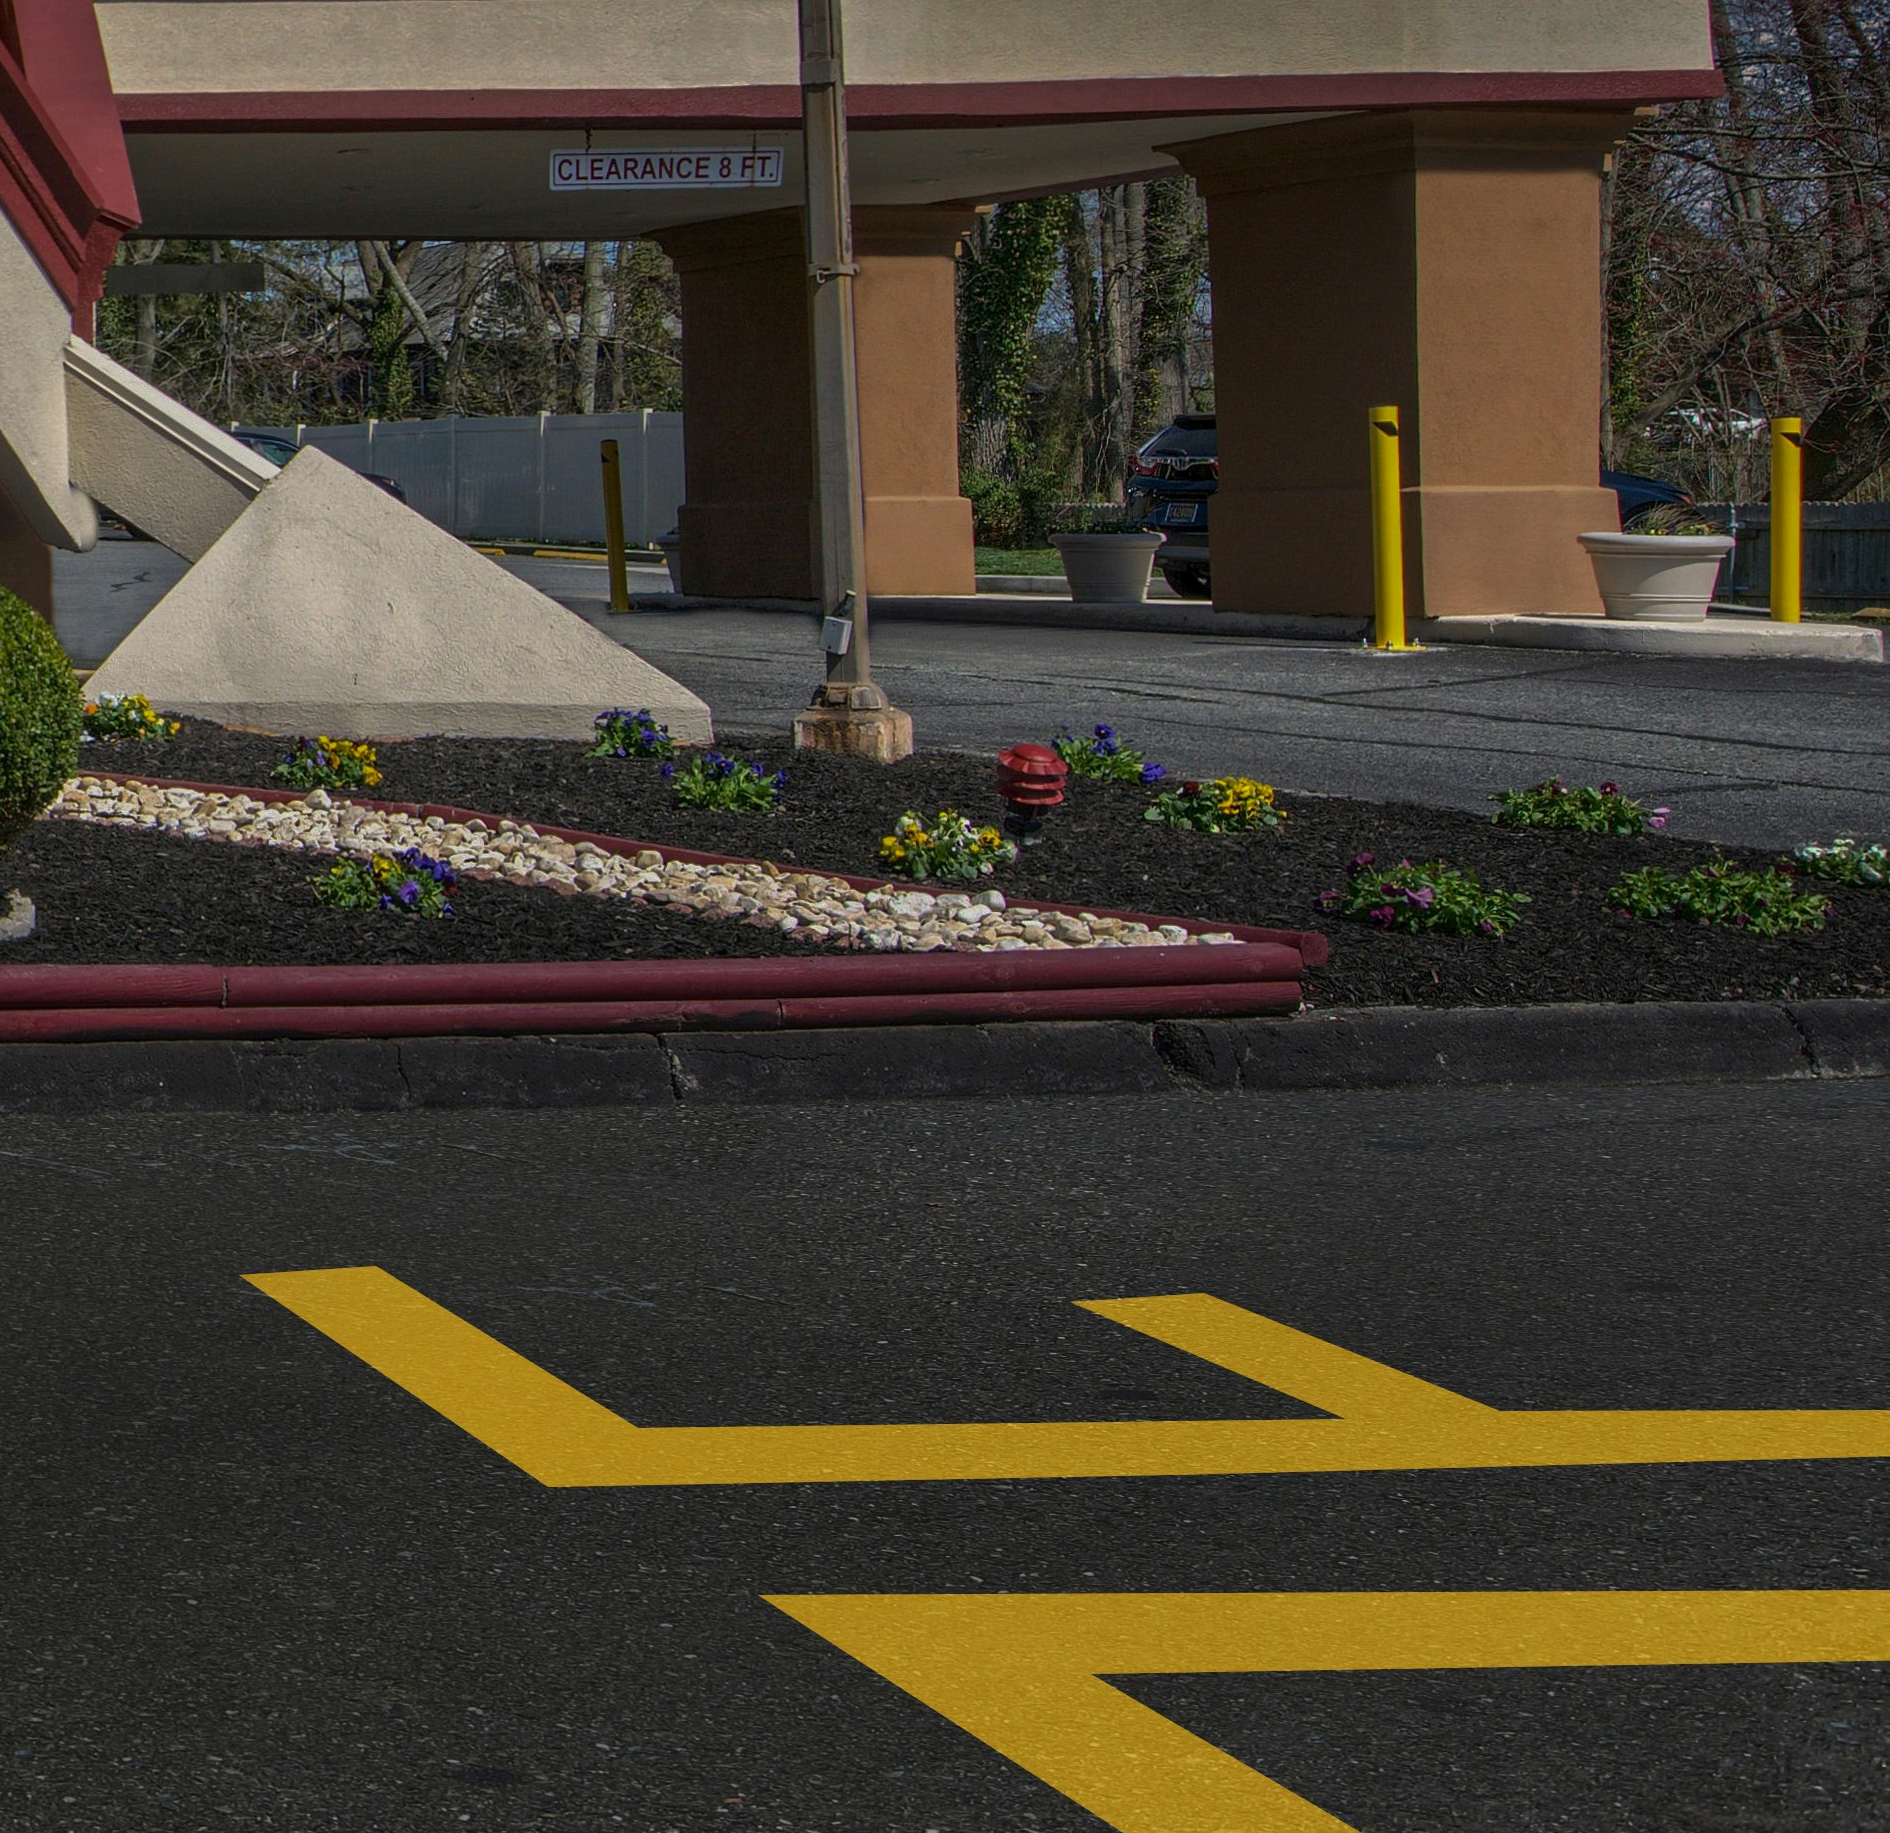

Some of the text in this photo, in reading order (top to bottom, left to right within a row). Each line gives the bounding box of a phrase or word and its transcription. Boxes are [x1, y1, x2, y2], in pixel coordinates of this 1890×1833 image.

[557, 155, 774, 181] CLEARANCE 8 FT.
